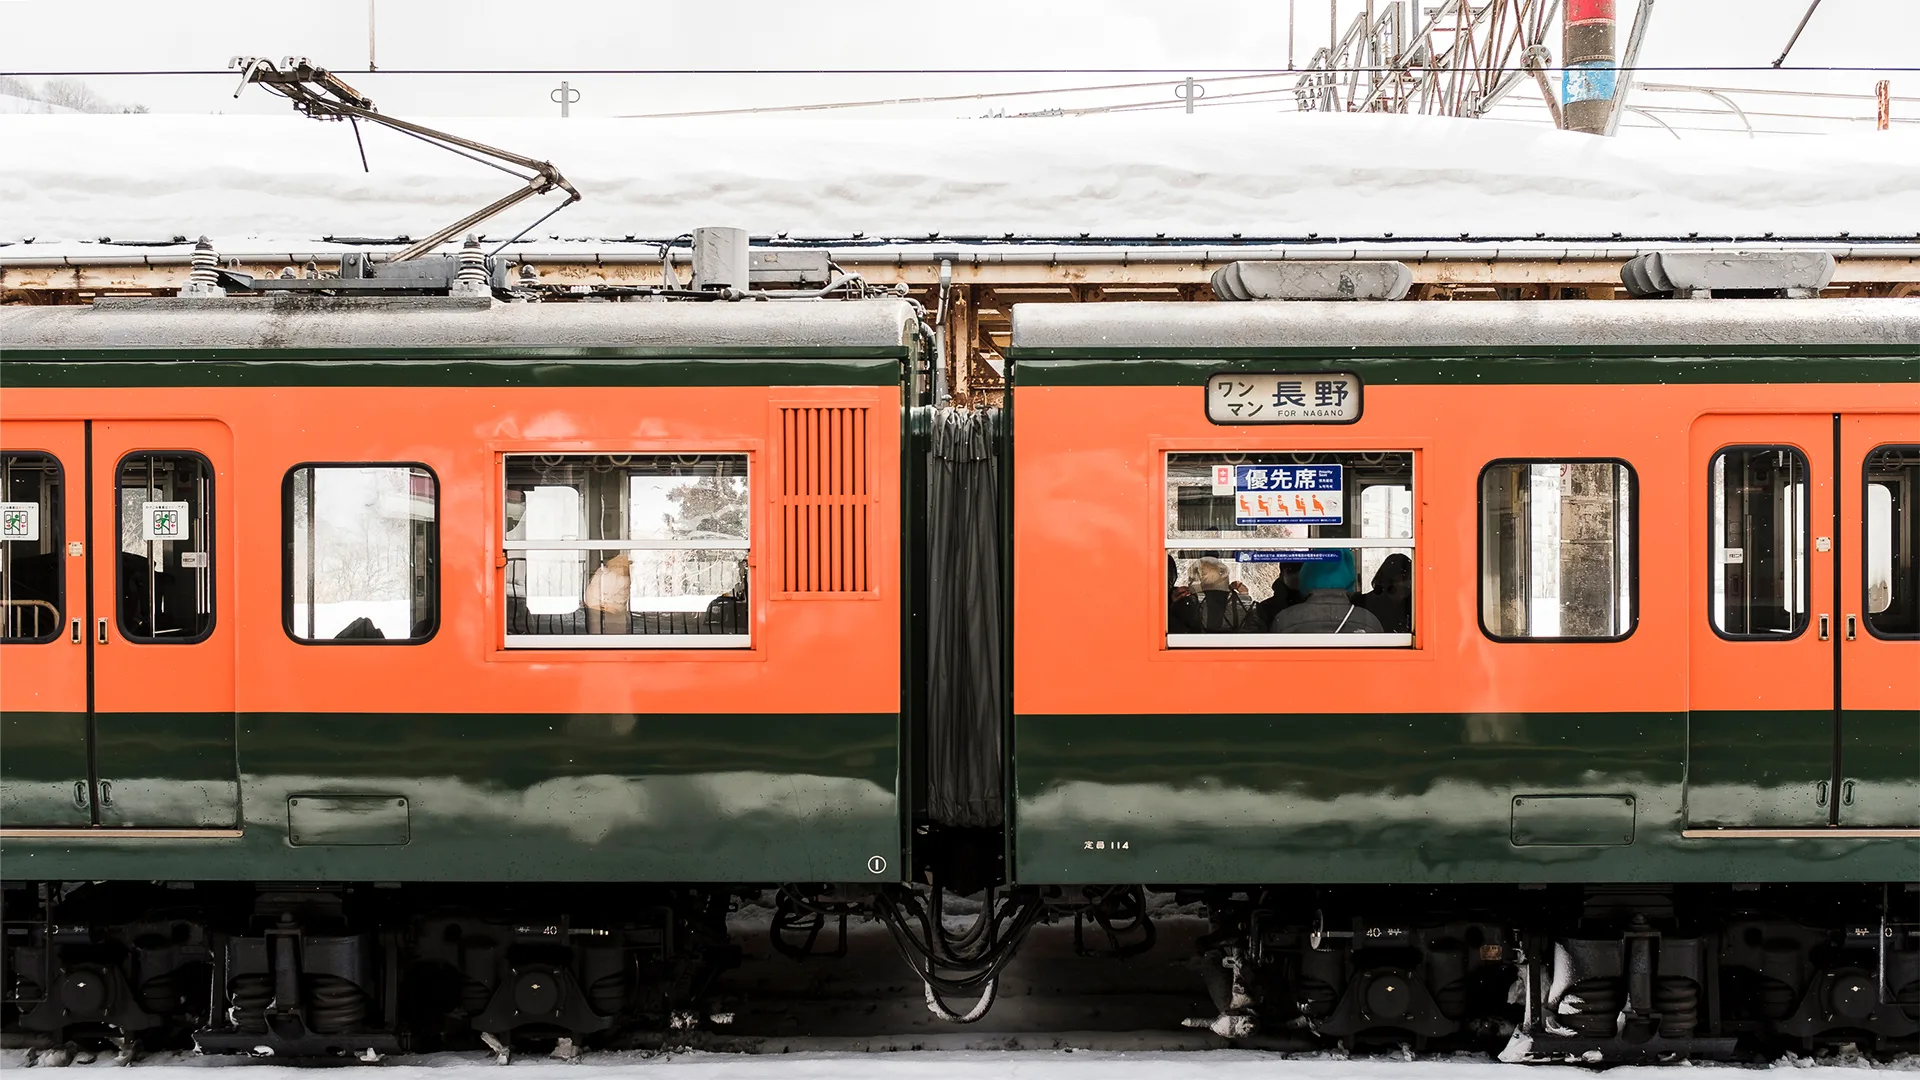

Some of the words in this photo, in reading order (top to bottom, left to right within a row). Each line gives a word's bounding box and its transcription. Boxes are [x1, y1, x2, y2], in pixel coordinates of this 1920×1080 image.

[1218, 381, 1254, 398] ワン
[1272, 381, 1349, 408] 長野
[1228, 402, 1263, 417] マン
[1245, 468, 1316, 490] 優先席
[1110, 841, 1129, 850] 114
[543, 926, 558, 934] 40
[1366, 928, 1382, 937] 40
